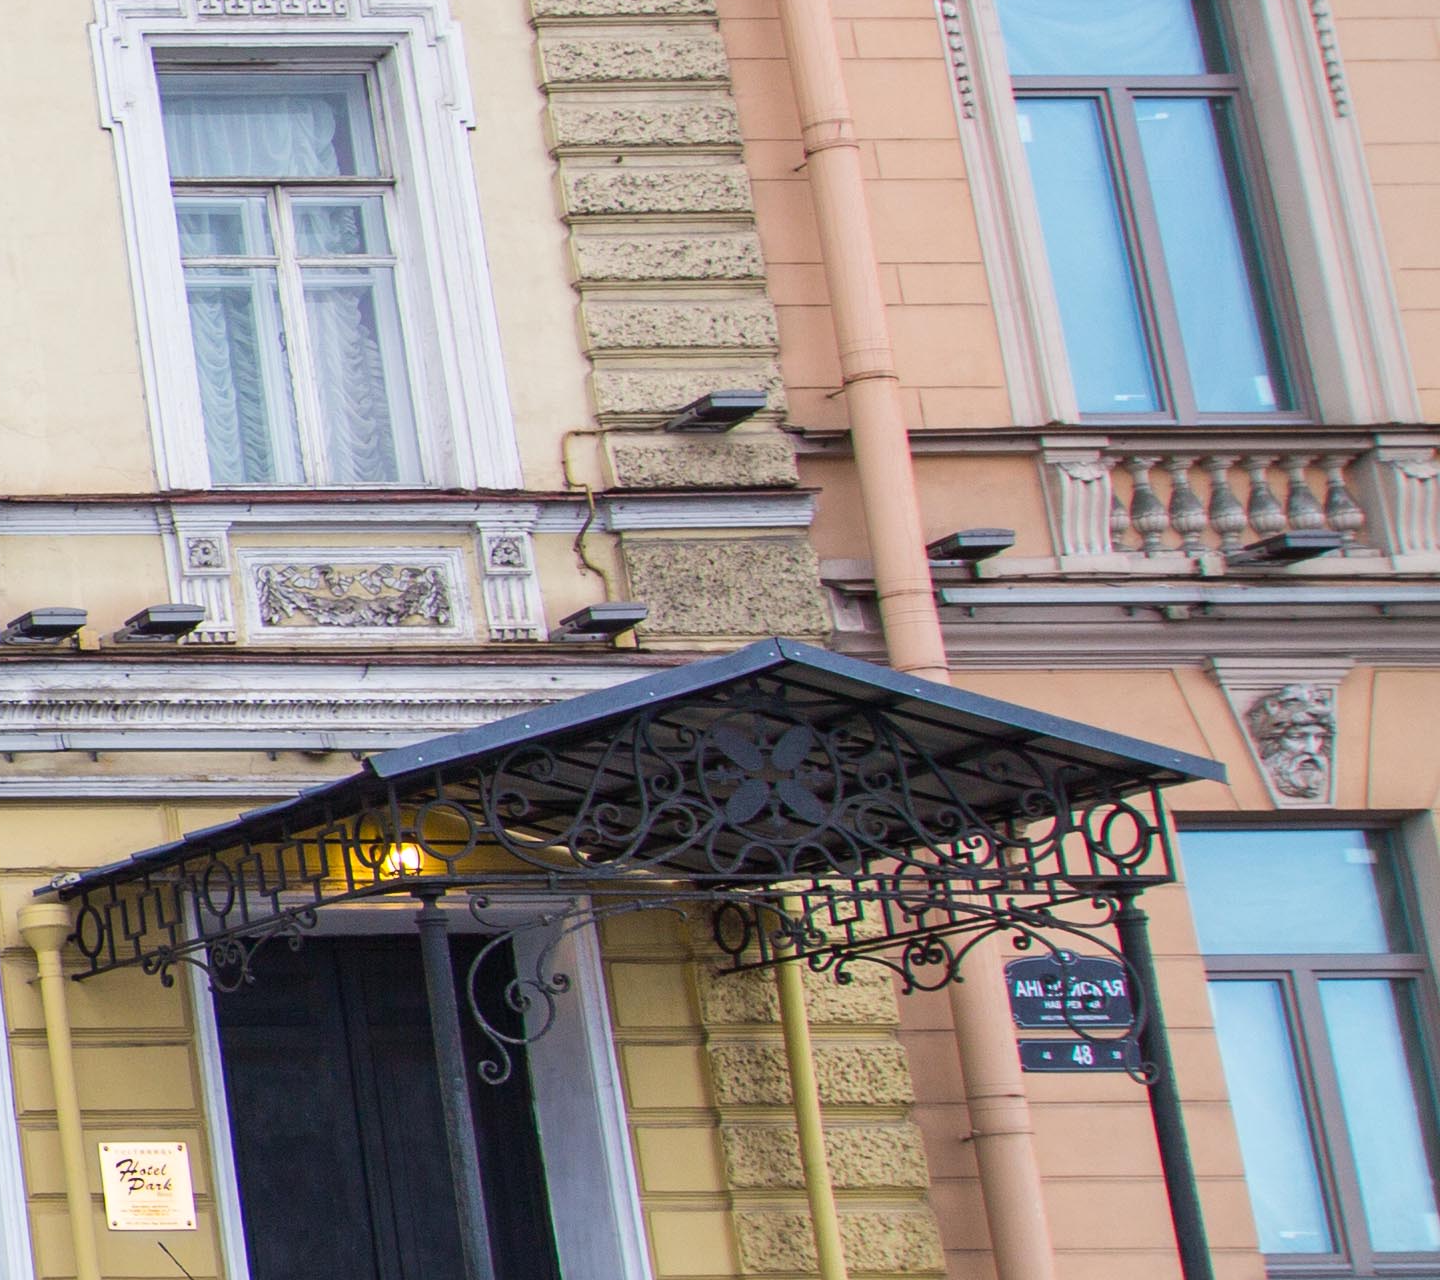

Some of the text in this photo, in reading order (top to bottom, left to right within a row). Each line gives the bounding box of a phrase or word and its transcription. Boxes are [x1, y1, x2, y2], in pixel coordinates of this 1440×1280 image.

[1072, 1045, 1093, 1064] 48
[116, 1159, 166, 1181] Hotel
[128, 1177, 172, 1195] Park
